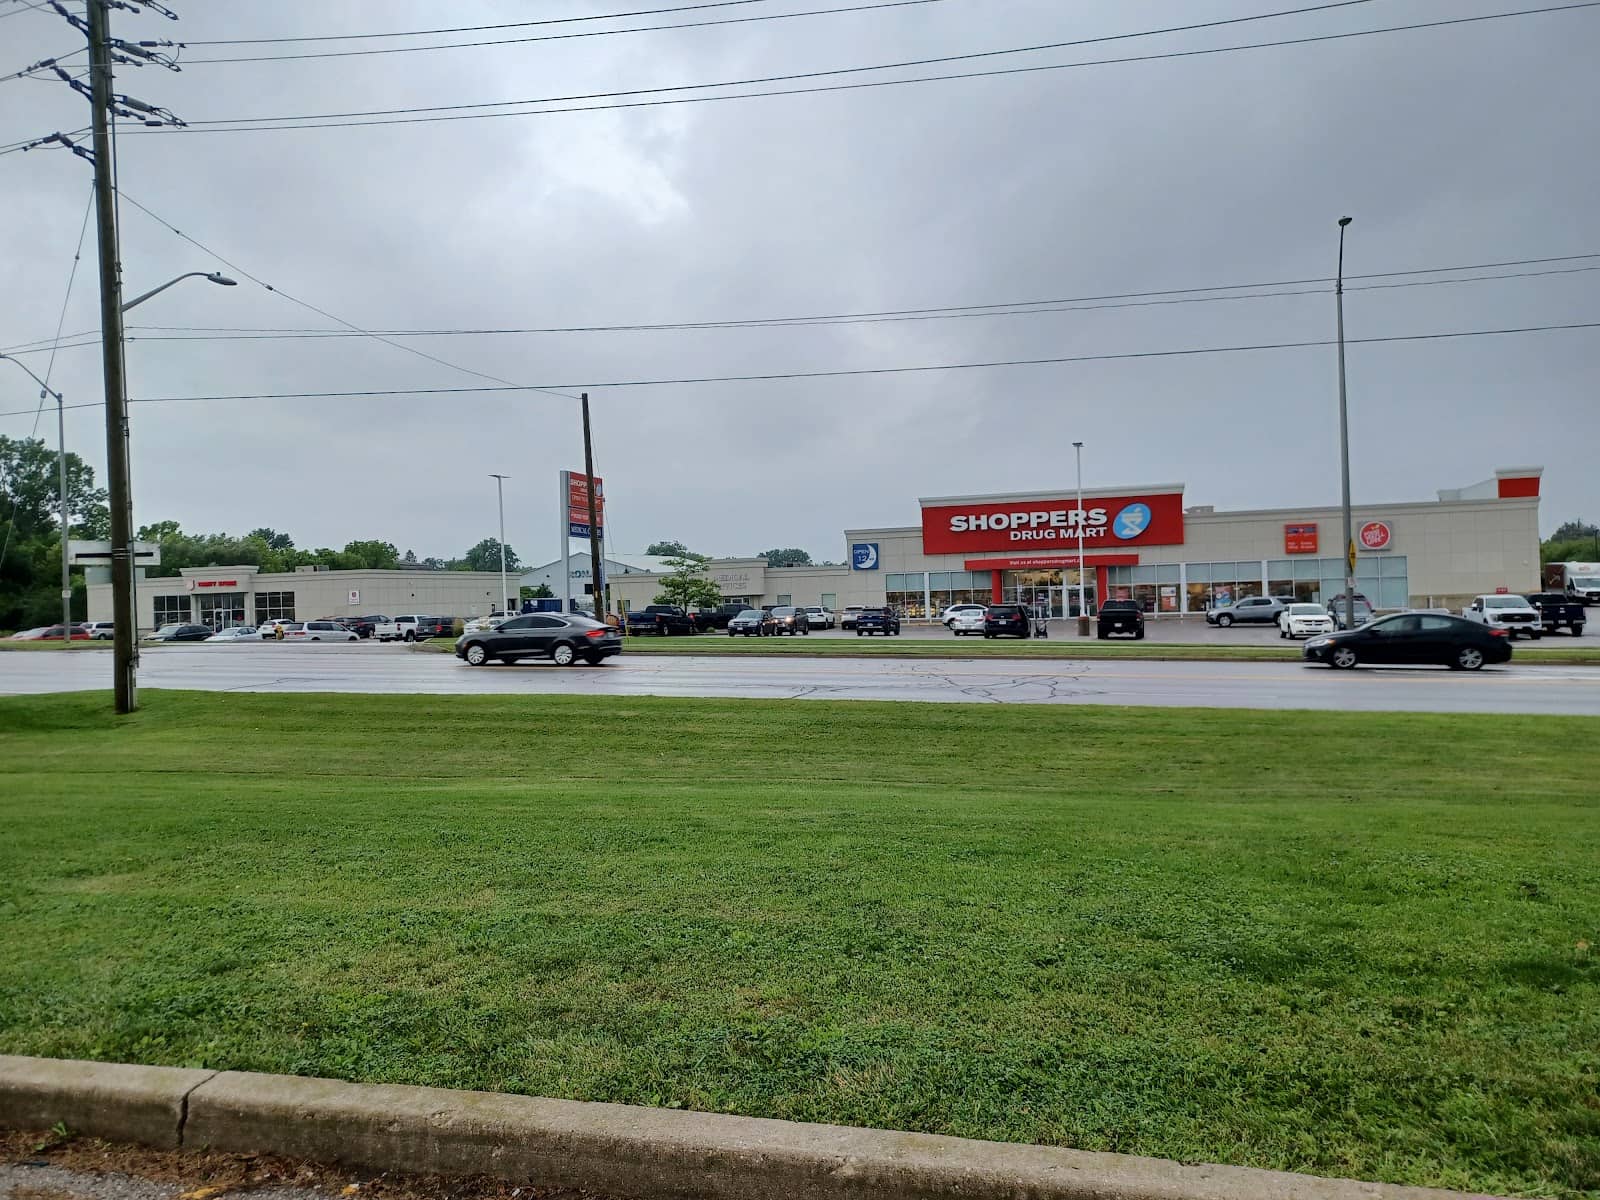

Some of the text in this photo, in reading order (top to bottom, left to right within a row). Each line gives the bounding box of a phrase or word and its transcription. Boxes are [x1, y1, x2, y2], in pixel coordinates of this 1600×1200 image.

[950, 508, 1107, 532] SHOPPERS
[1010, 526, 1107, 541] DRUG MART
